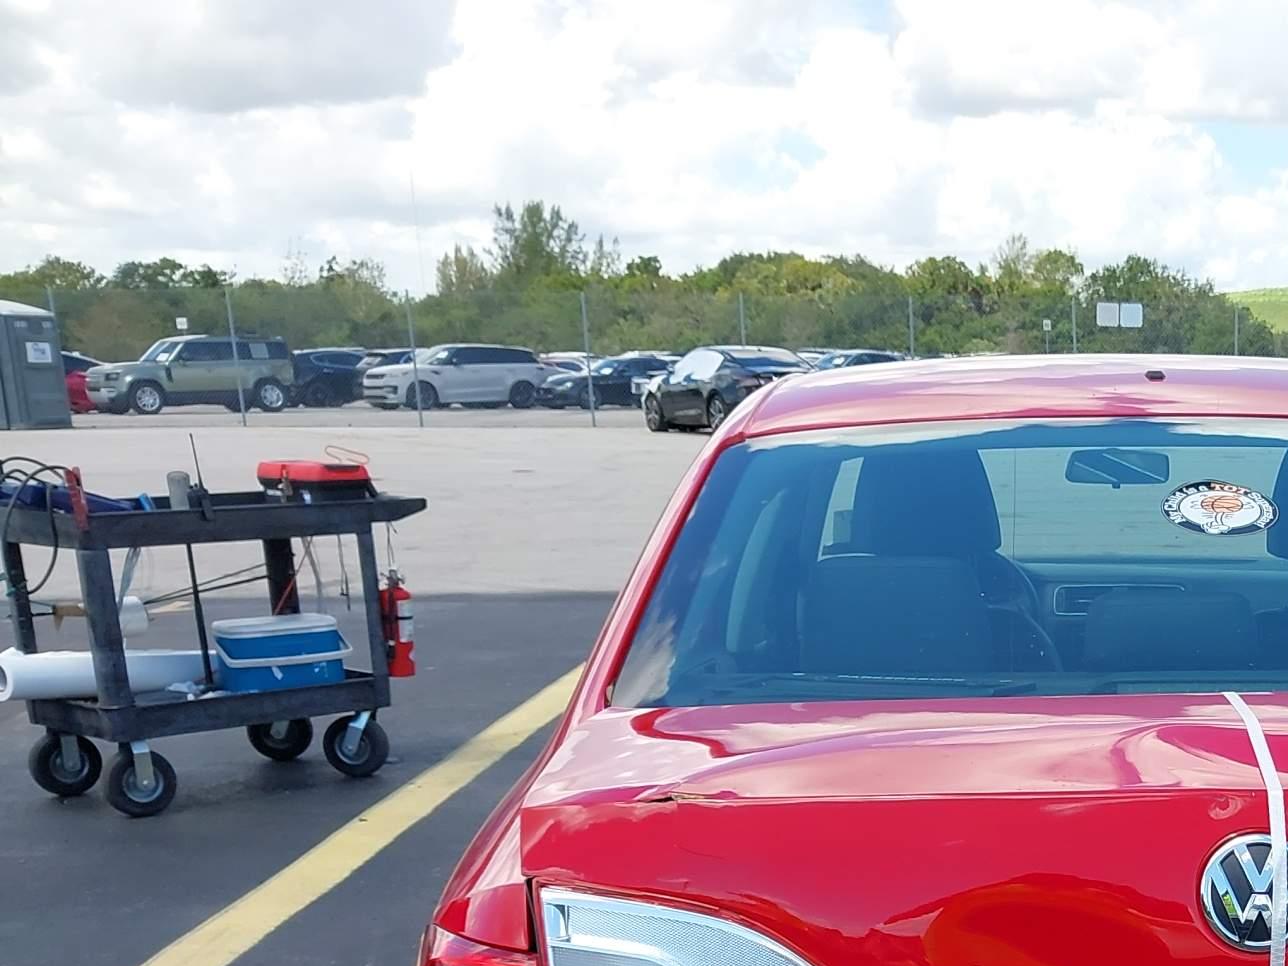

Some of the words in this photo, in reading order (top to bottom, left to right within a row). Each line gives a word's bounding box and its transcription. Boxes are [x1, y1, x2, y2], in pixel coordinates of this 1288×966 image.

[1211, 483, 1250, 495] TOT
[1164, 491, 1187, 511] Child
[1169, 511, 1186, 524] My
